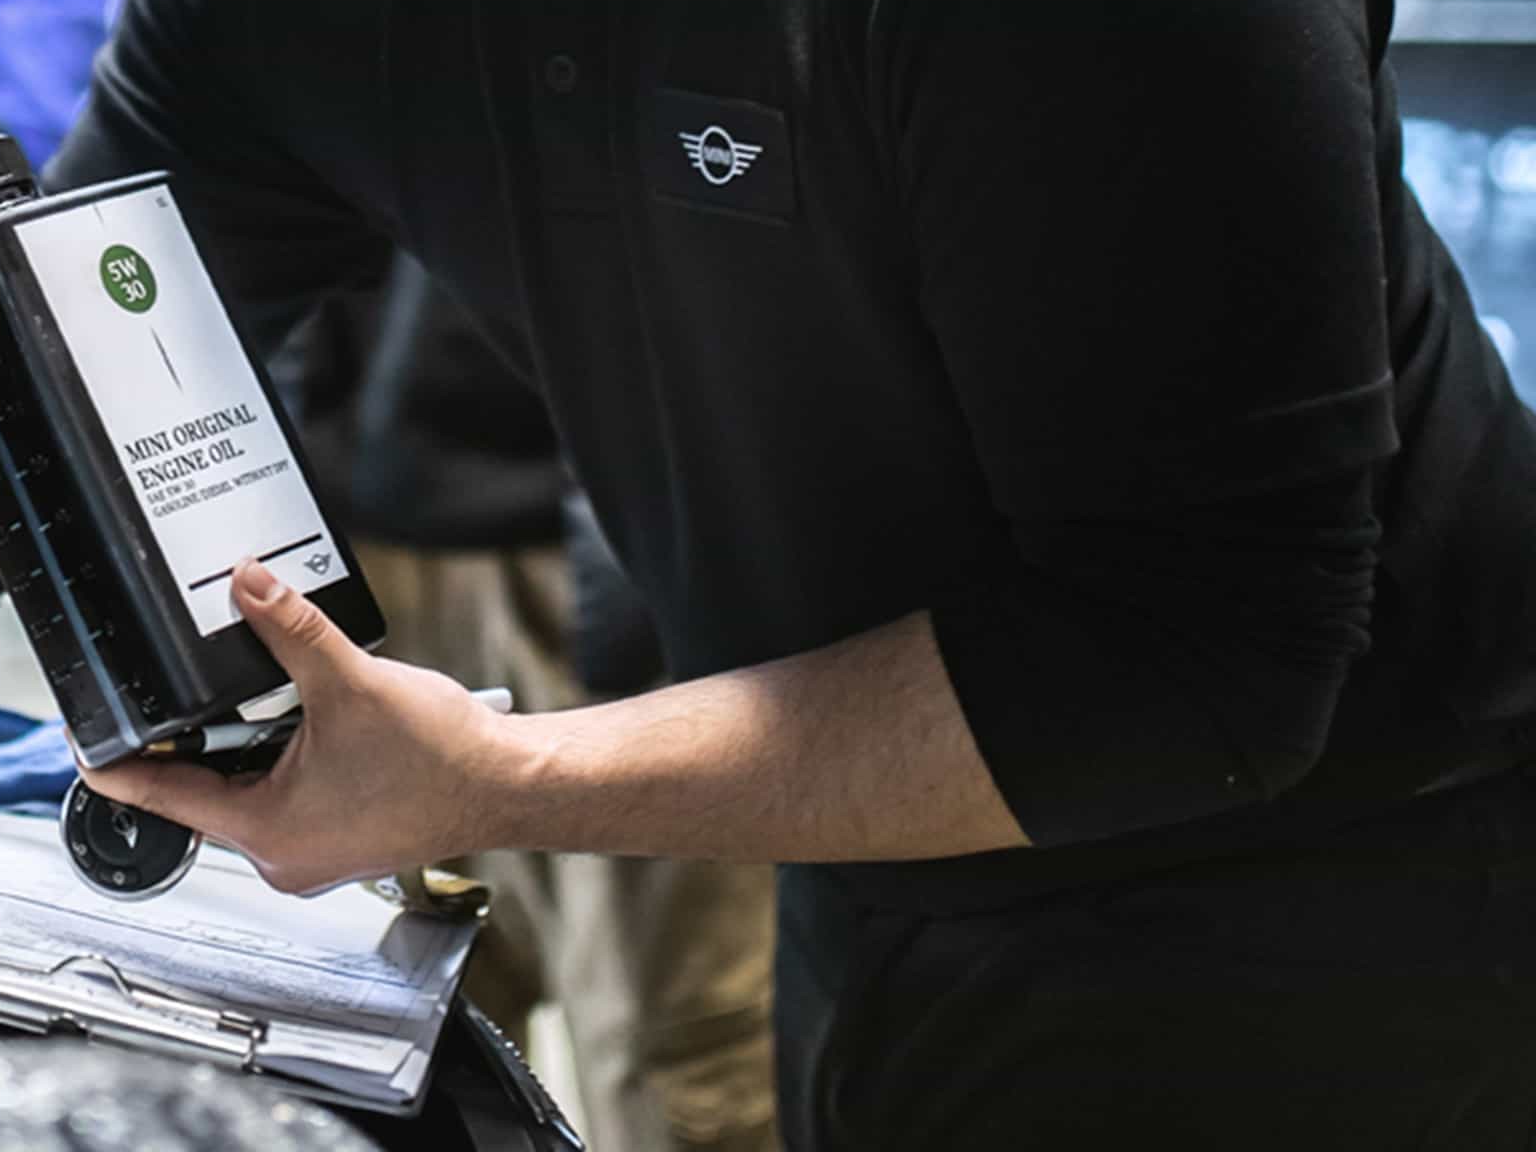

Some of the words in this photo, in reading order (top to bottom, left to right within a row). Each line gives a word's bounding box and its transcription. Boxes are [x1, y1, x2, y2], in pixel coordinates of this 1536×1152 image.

[107, 255, 138, 282] 5W
[120, 279, 147, 302] 30
[124, 431, 172, 464] MINI
[172, 404, 257, 446] ORIGINAL
[137, 449, 209, 489] ENGINE
[208, 438, 245, 464] OIL
